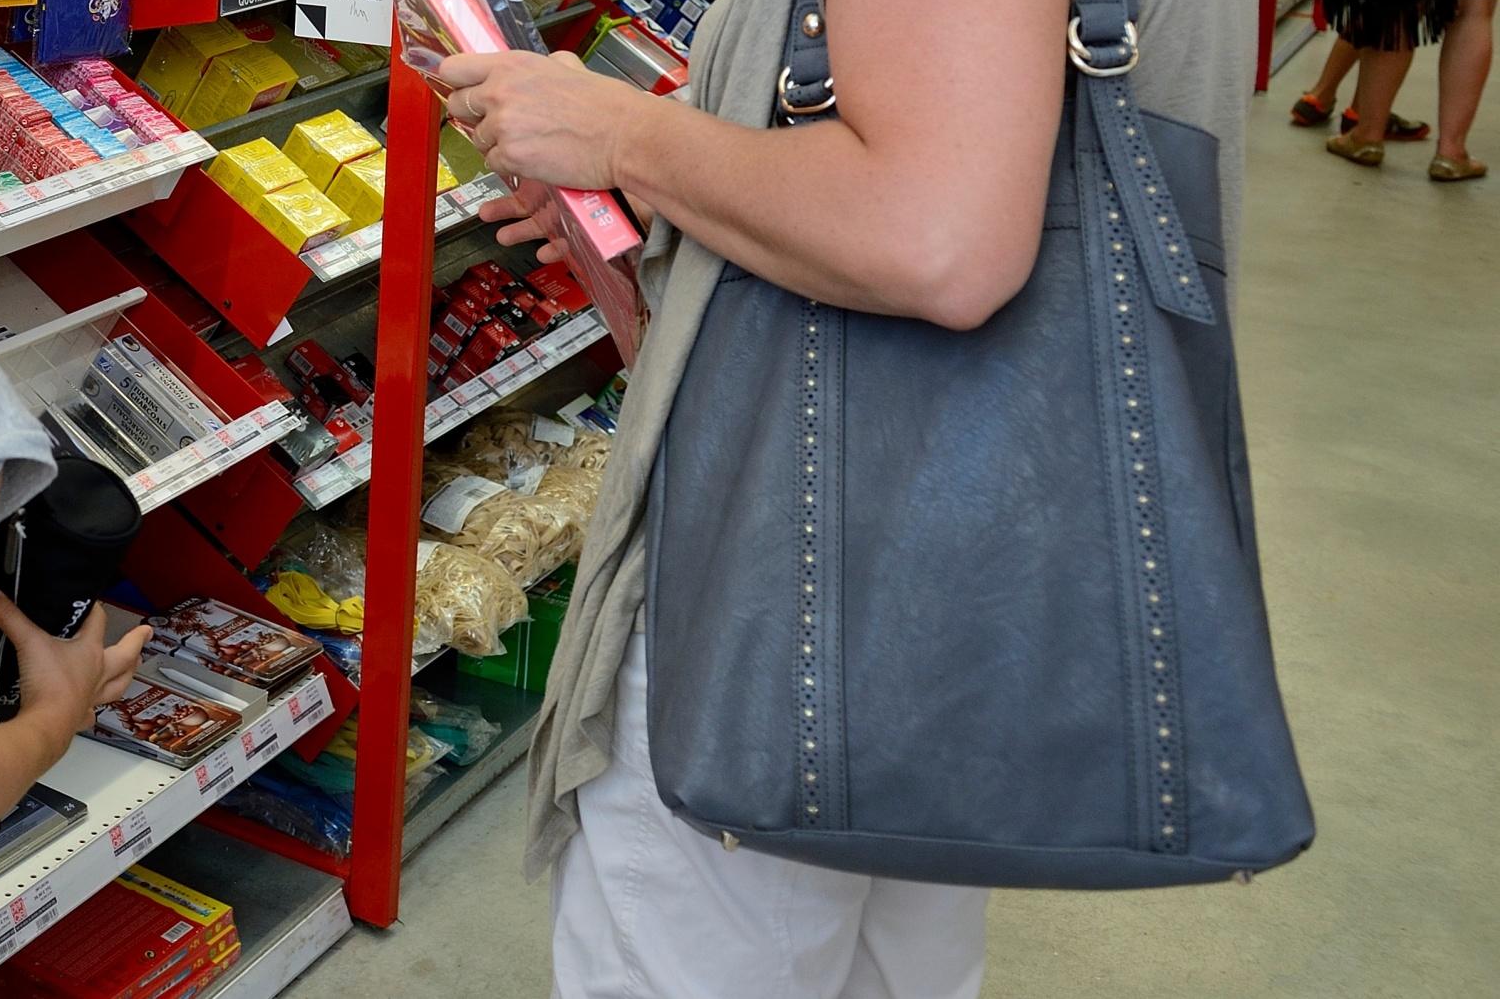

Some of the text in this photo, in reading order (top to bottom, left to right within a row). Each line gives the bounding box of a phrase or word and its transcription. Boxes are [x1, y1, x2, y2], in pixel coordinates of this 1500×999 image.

[119, 377, 158, 412] 5 FUSAINS
[130, 392, 166, 430] CHARCOALS
